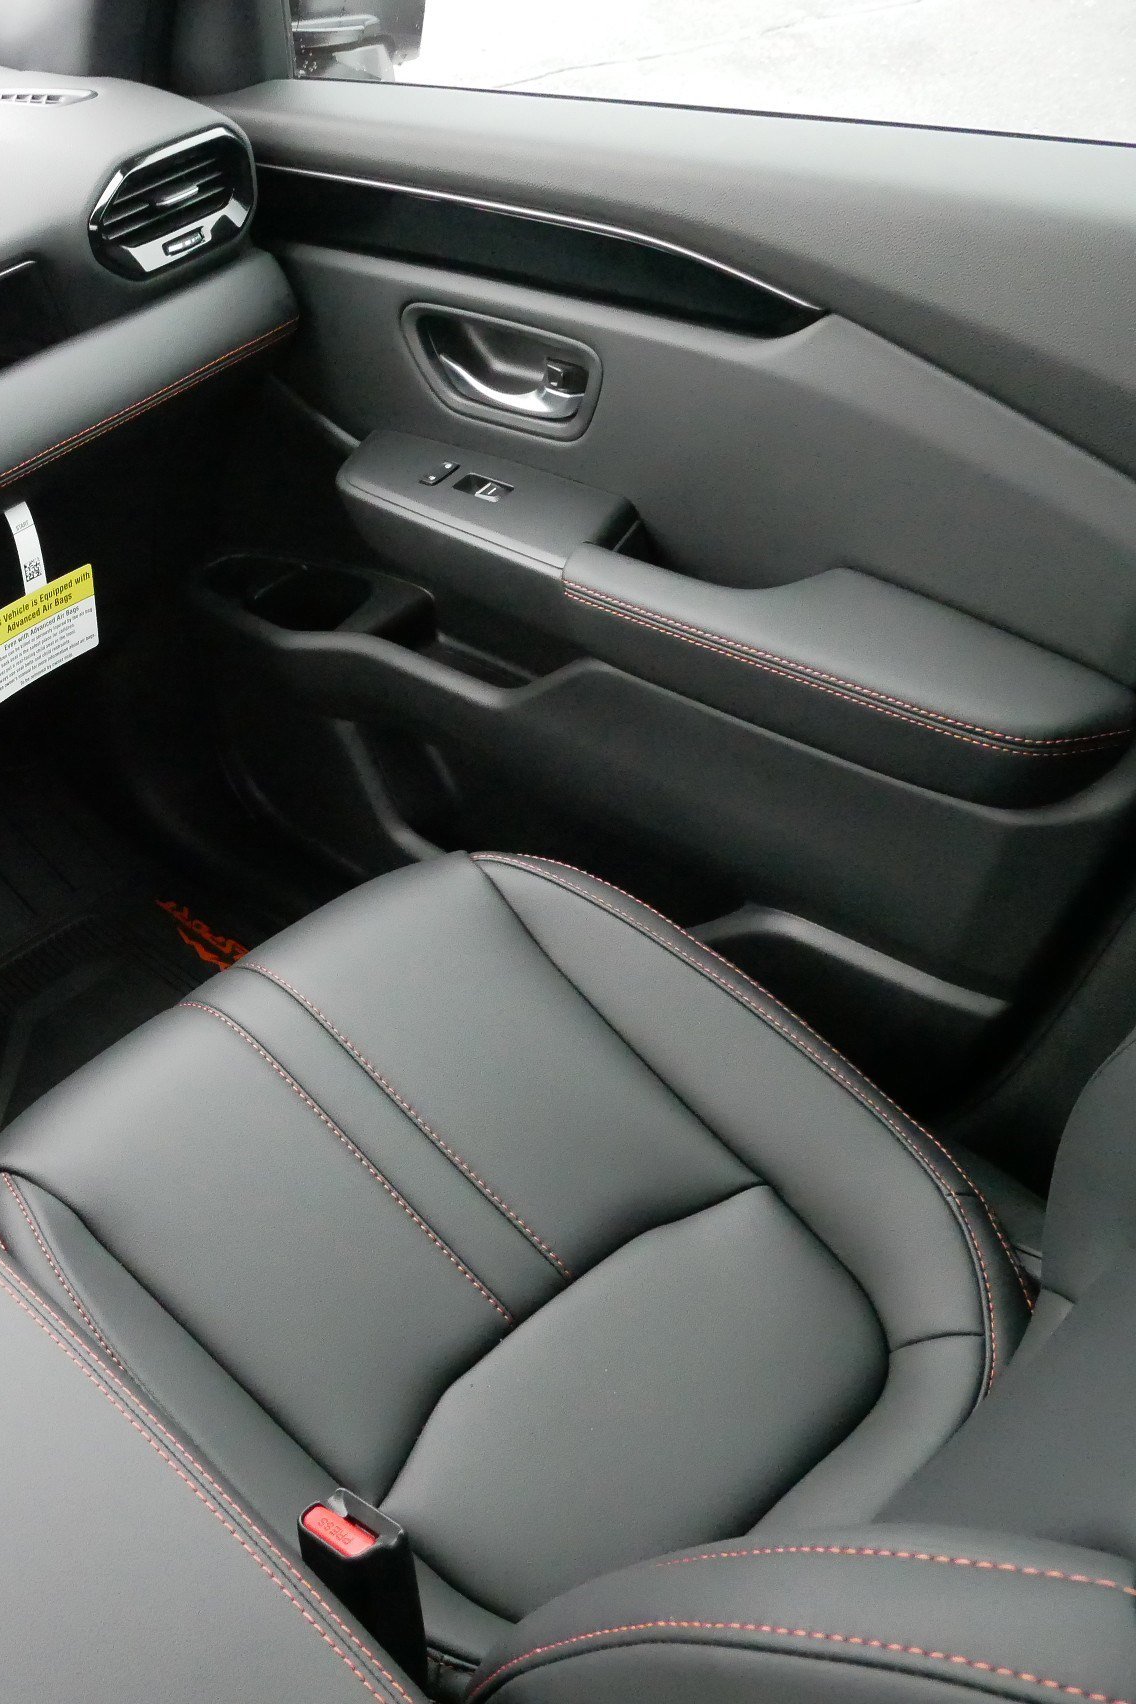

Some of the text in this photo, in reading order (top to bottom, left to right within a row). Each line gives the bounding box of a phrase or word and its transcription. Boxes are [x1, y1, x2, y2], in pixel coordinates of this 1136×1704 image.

[3, 603, 29, 622] Vehicle
[39, 580, 72, 604] Equipped
[75, 571, 90, 585] with
[7, 592, 72, 633] Advanced Air Bags
[4, 605, 79, 650] Even with Advanced Air Bags
